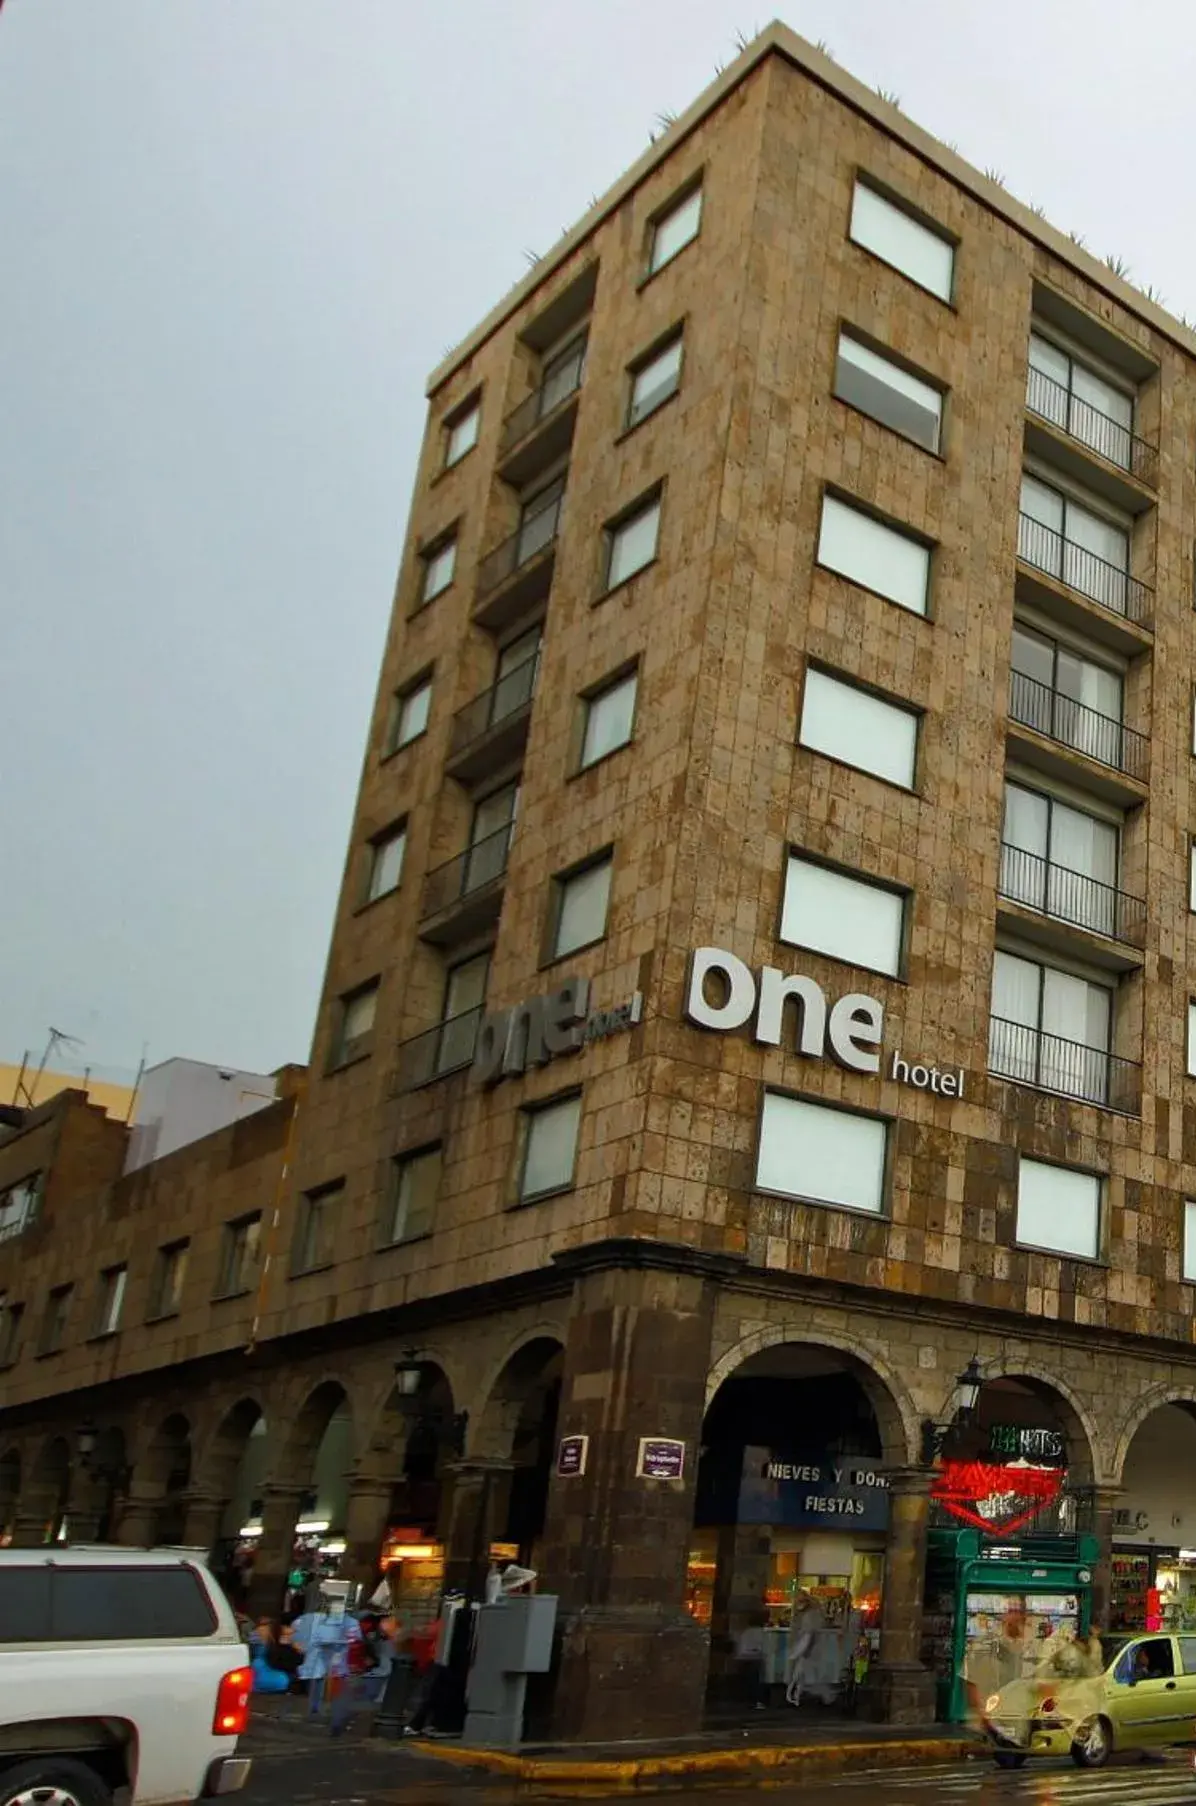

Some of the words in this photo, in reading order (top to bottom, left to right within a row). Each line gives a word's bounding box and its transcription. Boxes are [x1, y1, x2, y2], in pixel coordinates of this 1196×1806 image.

[891, 1051, 965, 1098] hotel
[767, 1462, 821, 1482] NIEVES
[833, 1468, 844, 1484] Y
[804, 1495, 865, 1515] FIESTAS
